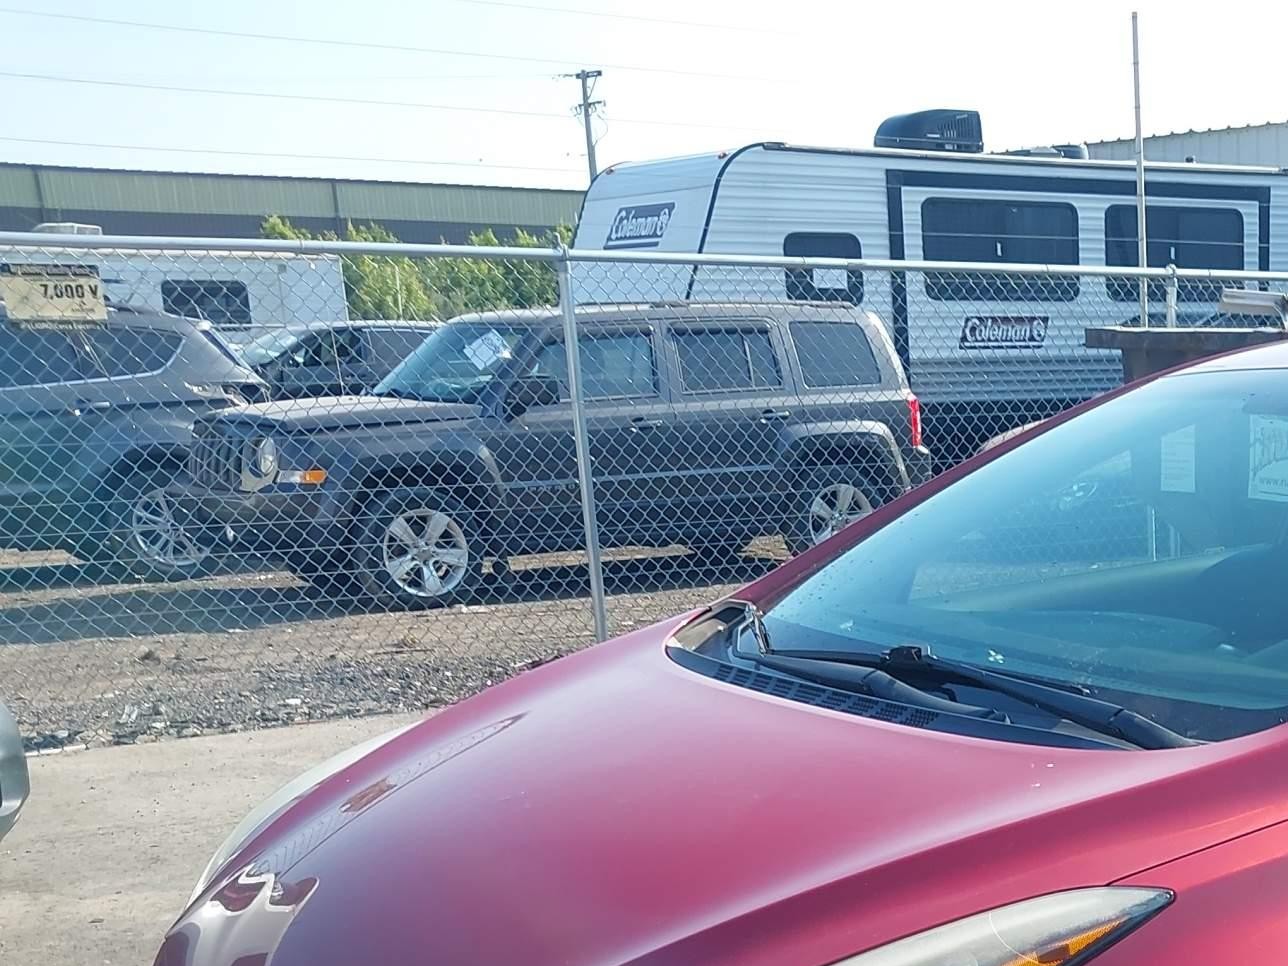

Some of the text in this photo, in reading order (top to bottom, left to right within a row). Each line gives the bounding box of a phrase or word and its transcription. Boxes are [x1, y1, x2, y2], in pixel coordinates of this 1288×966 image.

[611, 209, 659, 241] Coleman
[88, 284, 99, 300] V
[965, 318, 1030, 342] Coleman
